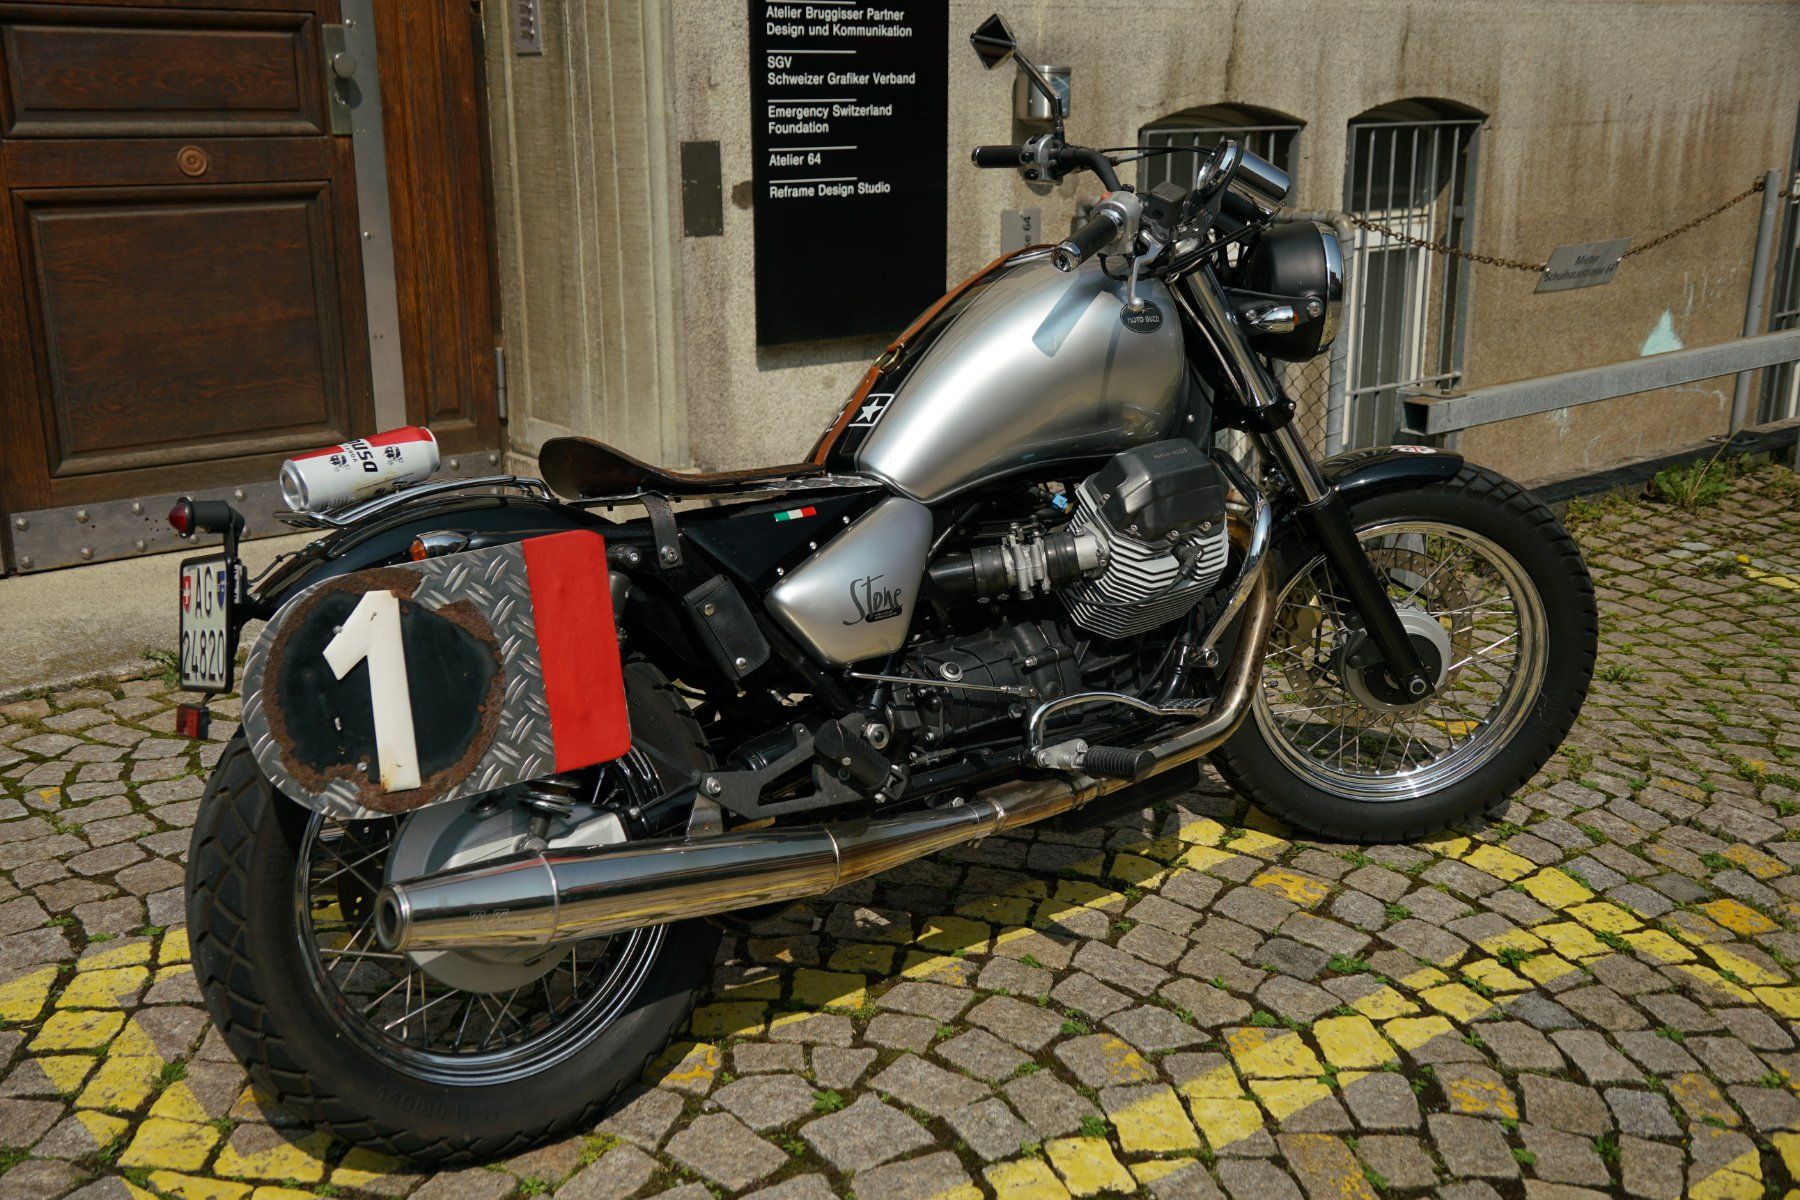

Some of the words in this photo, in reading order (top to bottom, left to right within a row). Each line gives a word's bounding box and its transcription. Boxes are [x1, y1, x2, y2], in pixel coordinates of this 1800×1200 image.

[766, 6, 802, 19] Atelier
[805, 7, 863, 21] Bruggisser
[866, 8, 905, 21] Partner
[766, 23, 805, 38] Design
[808, 24, 829, 36] und
[832, 24, 912, 37] Kommunikation
[767, 56, 792, 69] SGV
[767, 72, 824, 85] Schweizer
[827, 72, 869, 85] Grafiker
[873, 72, 916, 85] Verband
[768, 105, 829, 119] Emergency
[832, 104, 893, 117] Switzerland
[768, 122, 829, 134] Foundation
[769, 154, 804, 167] Atelier
[807, 153, 821, 165] 64
[769, 185, 815, 199] Reframe
[818, 183, 854, 198] Design
[857, 181, 891, 195] Studio
[195, 566, 214, 619] AG
[842, 574, 905, 625] Stone
[183, 629, 225, 681] 24820
[322, 589, 422, 794] 1
